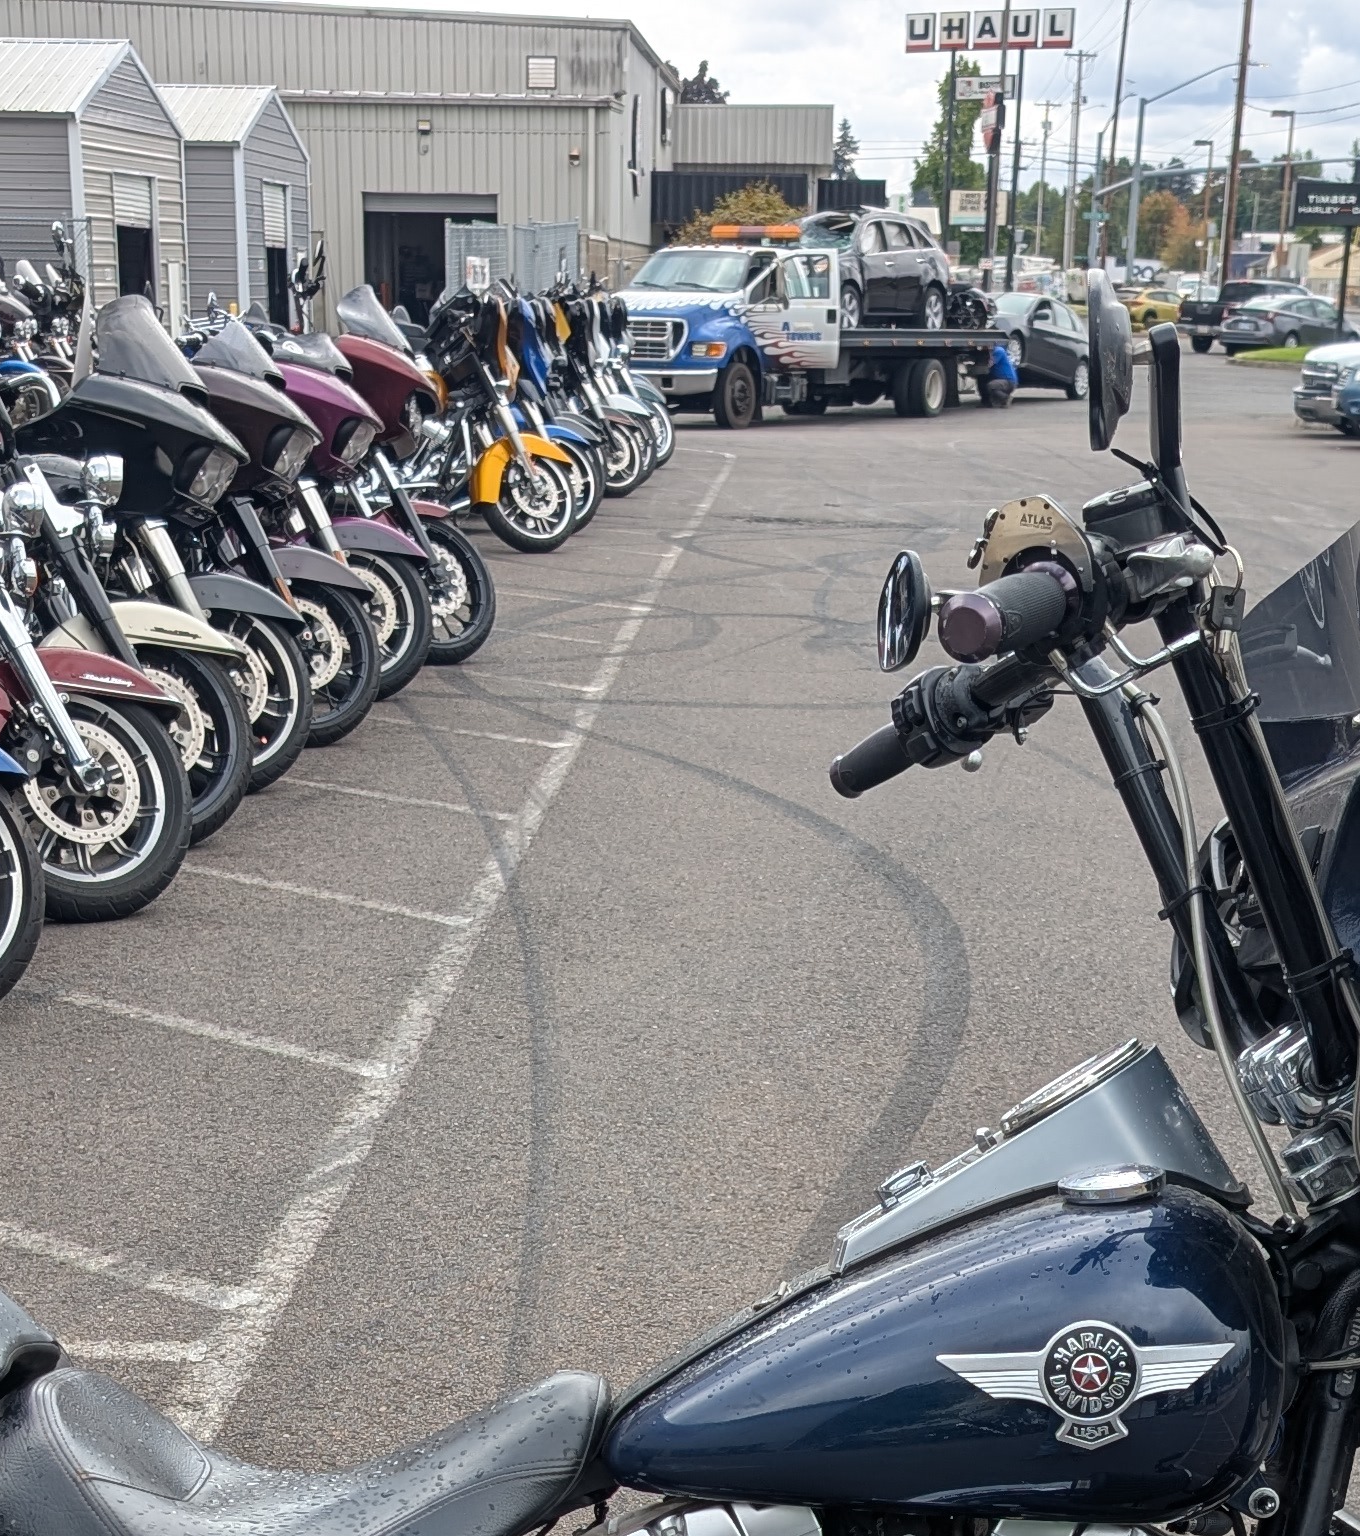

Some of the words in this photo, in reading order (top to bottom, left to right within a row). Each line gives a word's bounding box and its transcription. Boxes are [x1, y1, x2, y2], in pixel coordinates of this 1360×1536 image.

[1307, 194, 1357, 205] TIMBER
[1019, 513, 1053, 526] ATLAS
[1053, 1332, 1128, 1364] HARLEY
[1049, 1371, 1132, 1414] DAVIDSON
